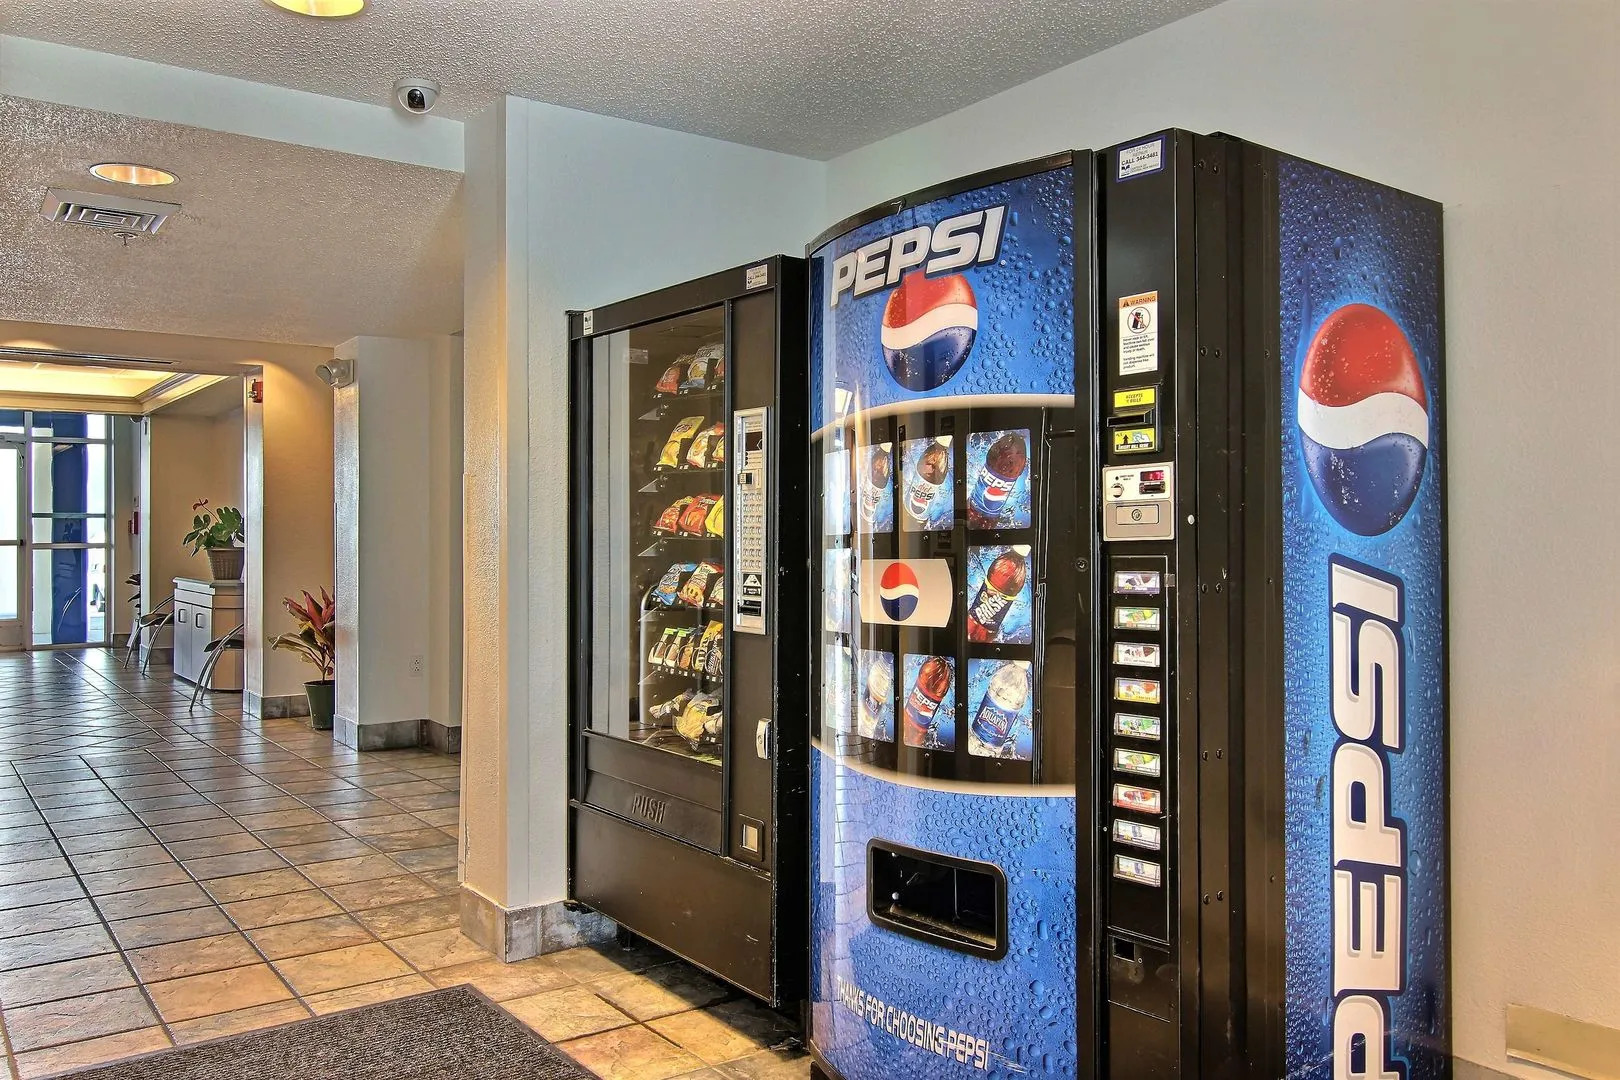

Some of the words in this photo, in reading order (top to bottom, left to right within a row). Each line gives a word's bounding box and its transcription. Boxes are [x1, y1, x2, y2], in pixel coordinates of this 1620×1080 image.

[831, 206, 1005, 307] PEPSI
[1130, 296, 1155, 305] WARNING
[975, 593, 1008, 625] BRISK
[913, 686, 938, 710] PEPSI
[632, 793, 666, 824] PUSH
[1331, 562, 1401, 1080] PEPSI
[837, 976, 865, 1017] THANKS
[865, 994, 886, 1030] FOR
[886, 1005, 945, 1056] CHOOSING
[946, 1029, 989, 1071] PEPSI
